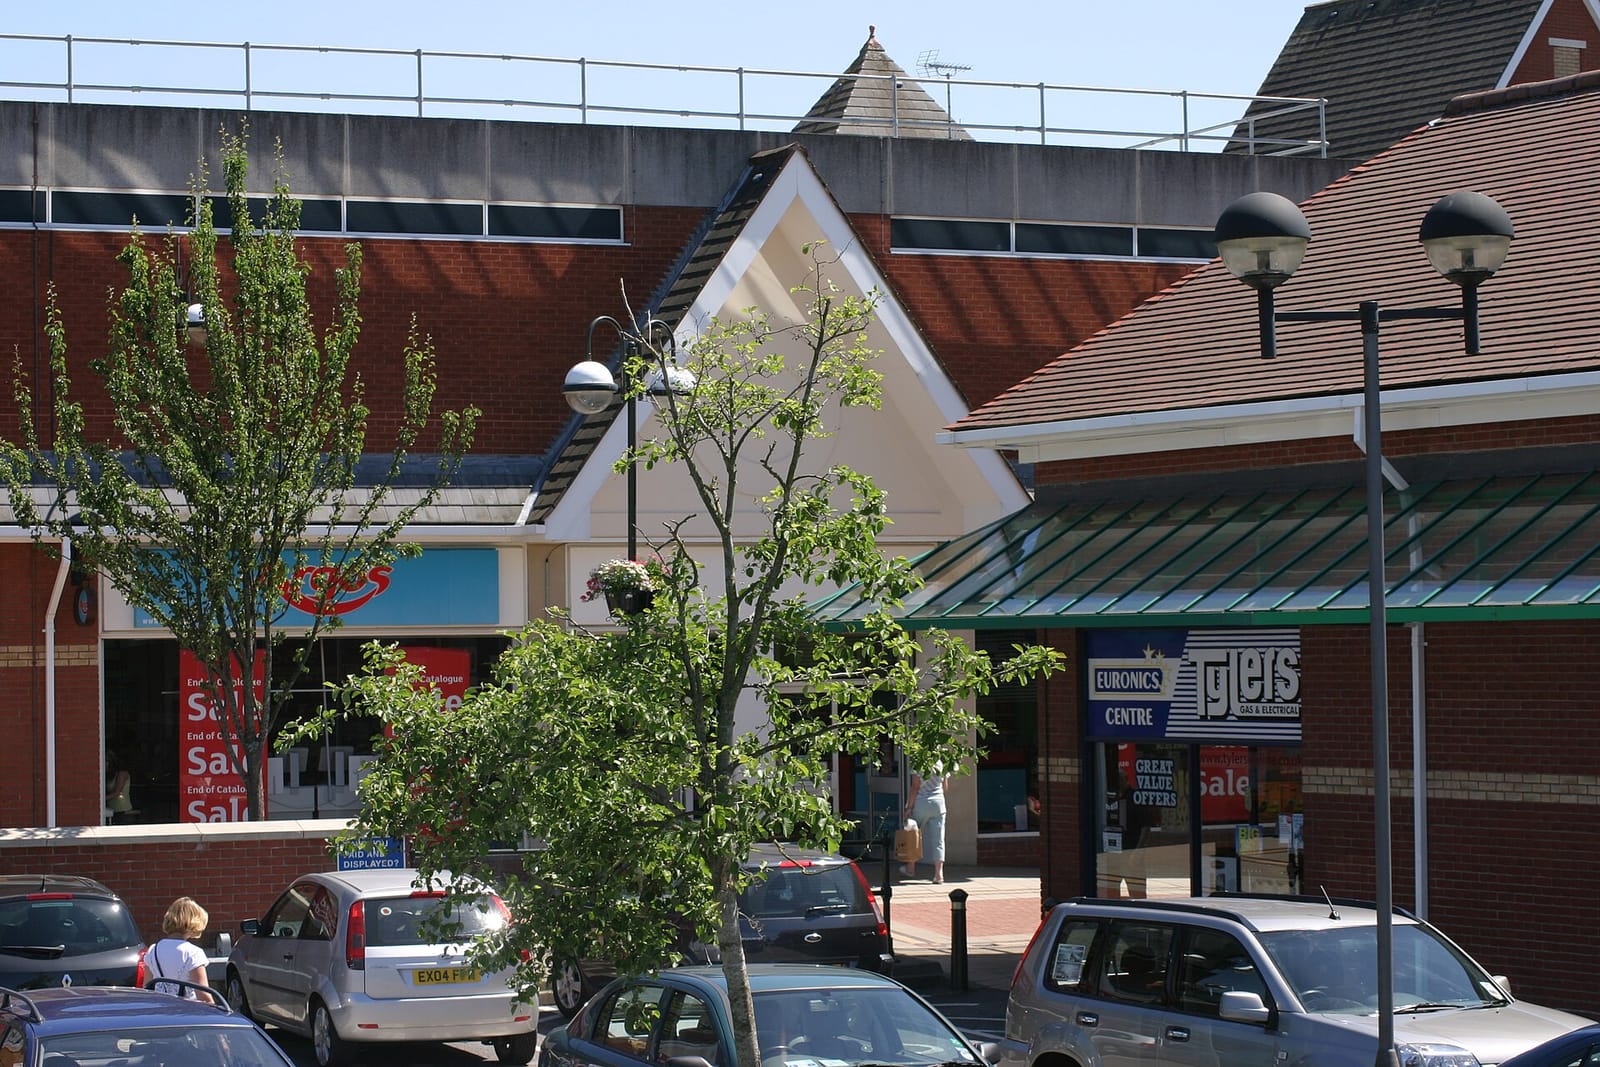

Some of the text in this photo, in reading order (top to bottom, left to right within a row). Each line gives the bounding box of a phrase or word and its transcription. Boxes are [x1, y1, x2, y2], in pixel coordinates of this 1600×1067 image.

[1097, 671, 1160, 689] EURONICS
[1188, 647, 1299, 716] Tylers
[1105, 707, 1153, 725] CENTRE
[1240, 705, 1298, 715] GAS & ELECTRICAL
[187, 732, 204, 740] End
[206, 732, 215, 740] of
[188, 744, 250, 775] Sal
[1136, 759, 1174, 774] GREAT
[1137, 775, 1173, 790] VALUE
[187, 785, 247, 794] End of Catalo
[1133, 791, 1177, 806] OFFERS
[1239, 827, 1260, 839] BIG
[344, 850, 364, 858] AID
[344, 859, 399, 869] DISPLAYED?
[418, 970, 449, 982] EX04
